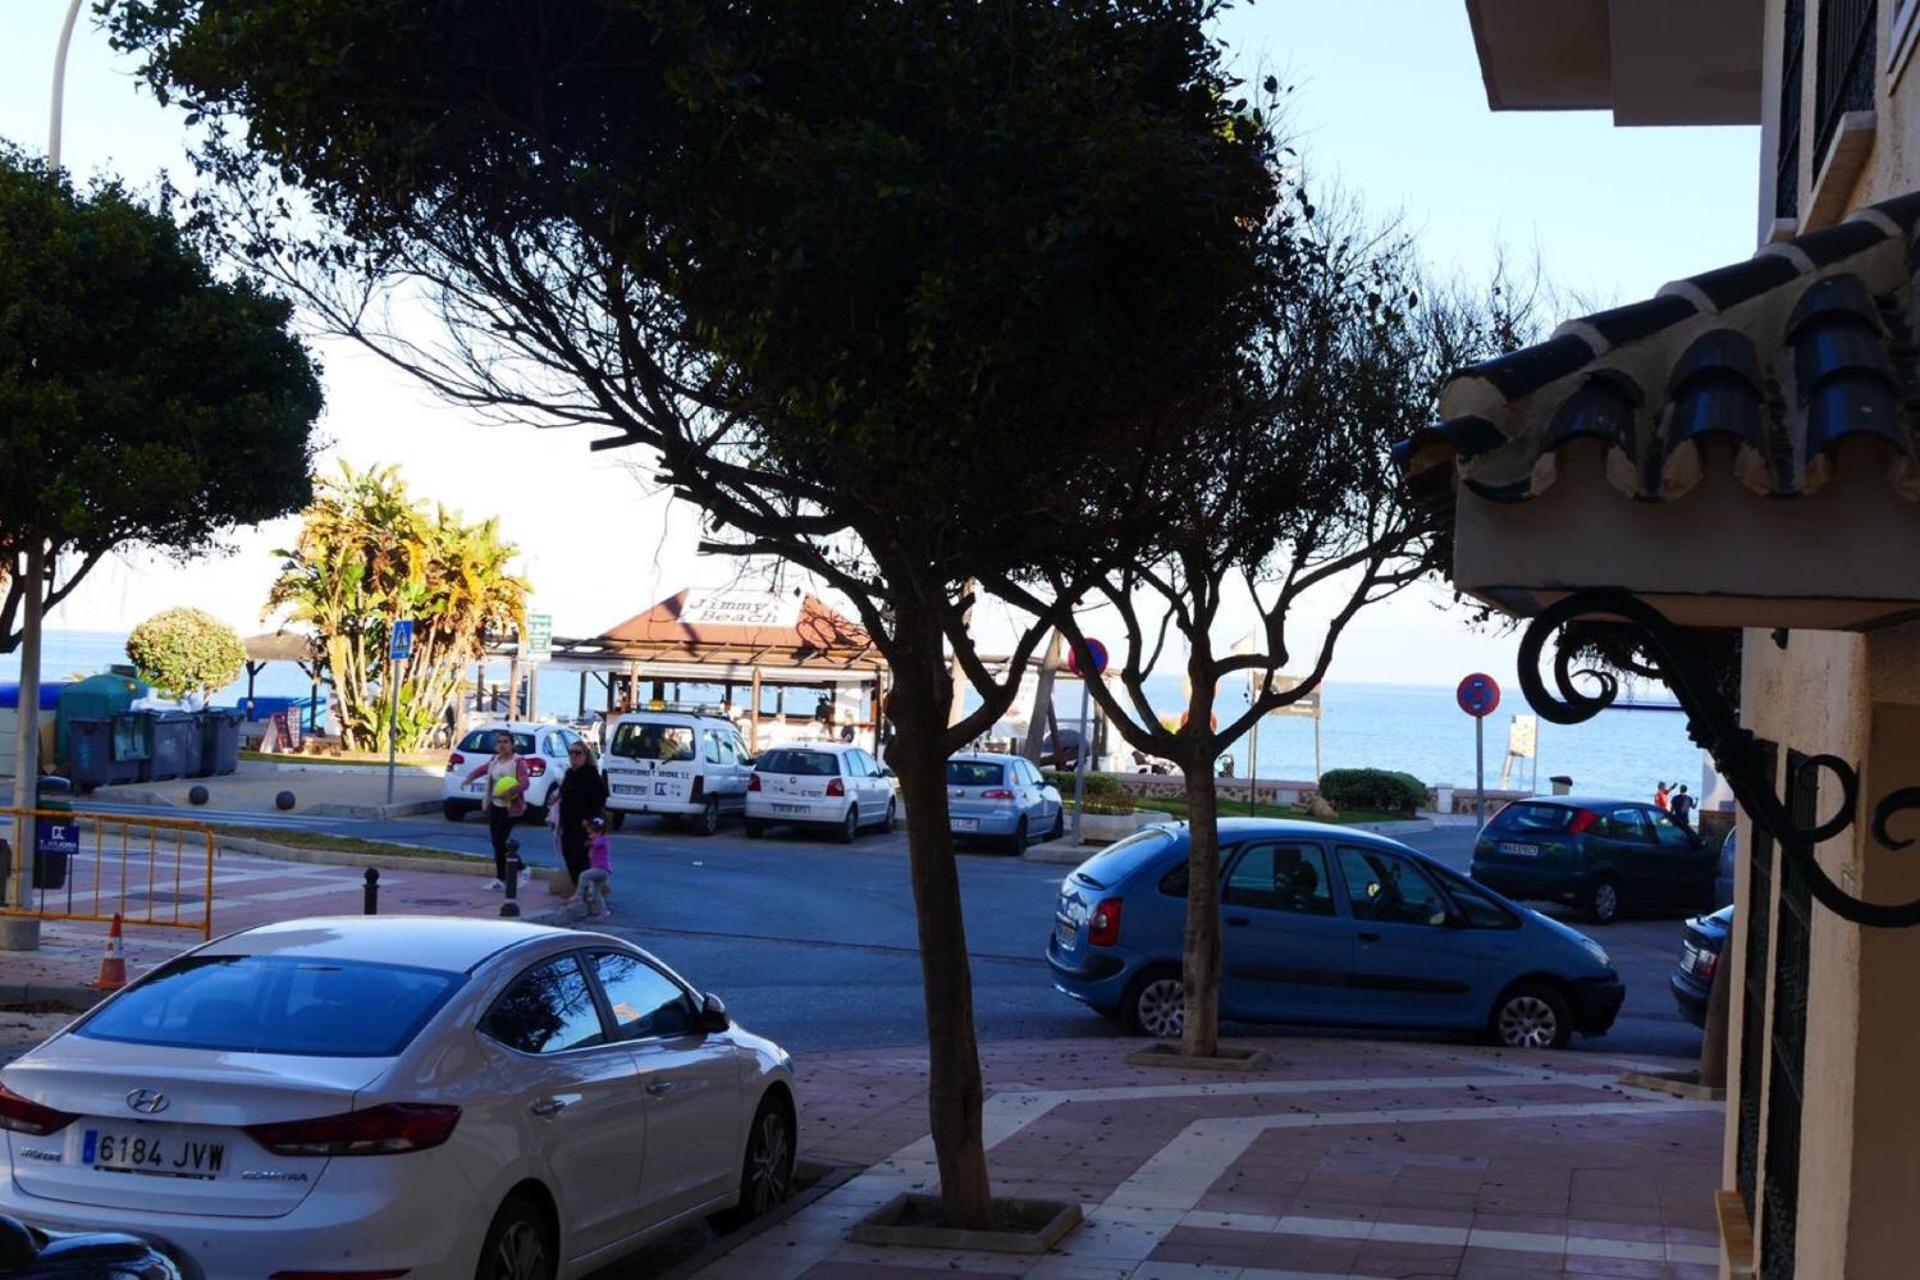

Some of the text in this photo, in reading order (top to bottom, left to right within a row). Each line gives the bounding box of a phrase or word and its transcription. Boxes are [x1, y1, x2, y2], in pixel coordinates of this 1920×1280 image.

[699, 610, 778, 623] Beach
[100, 1135, 225, 1170] 6184 JVW
